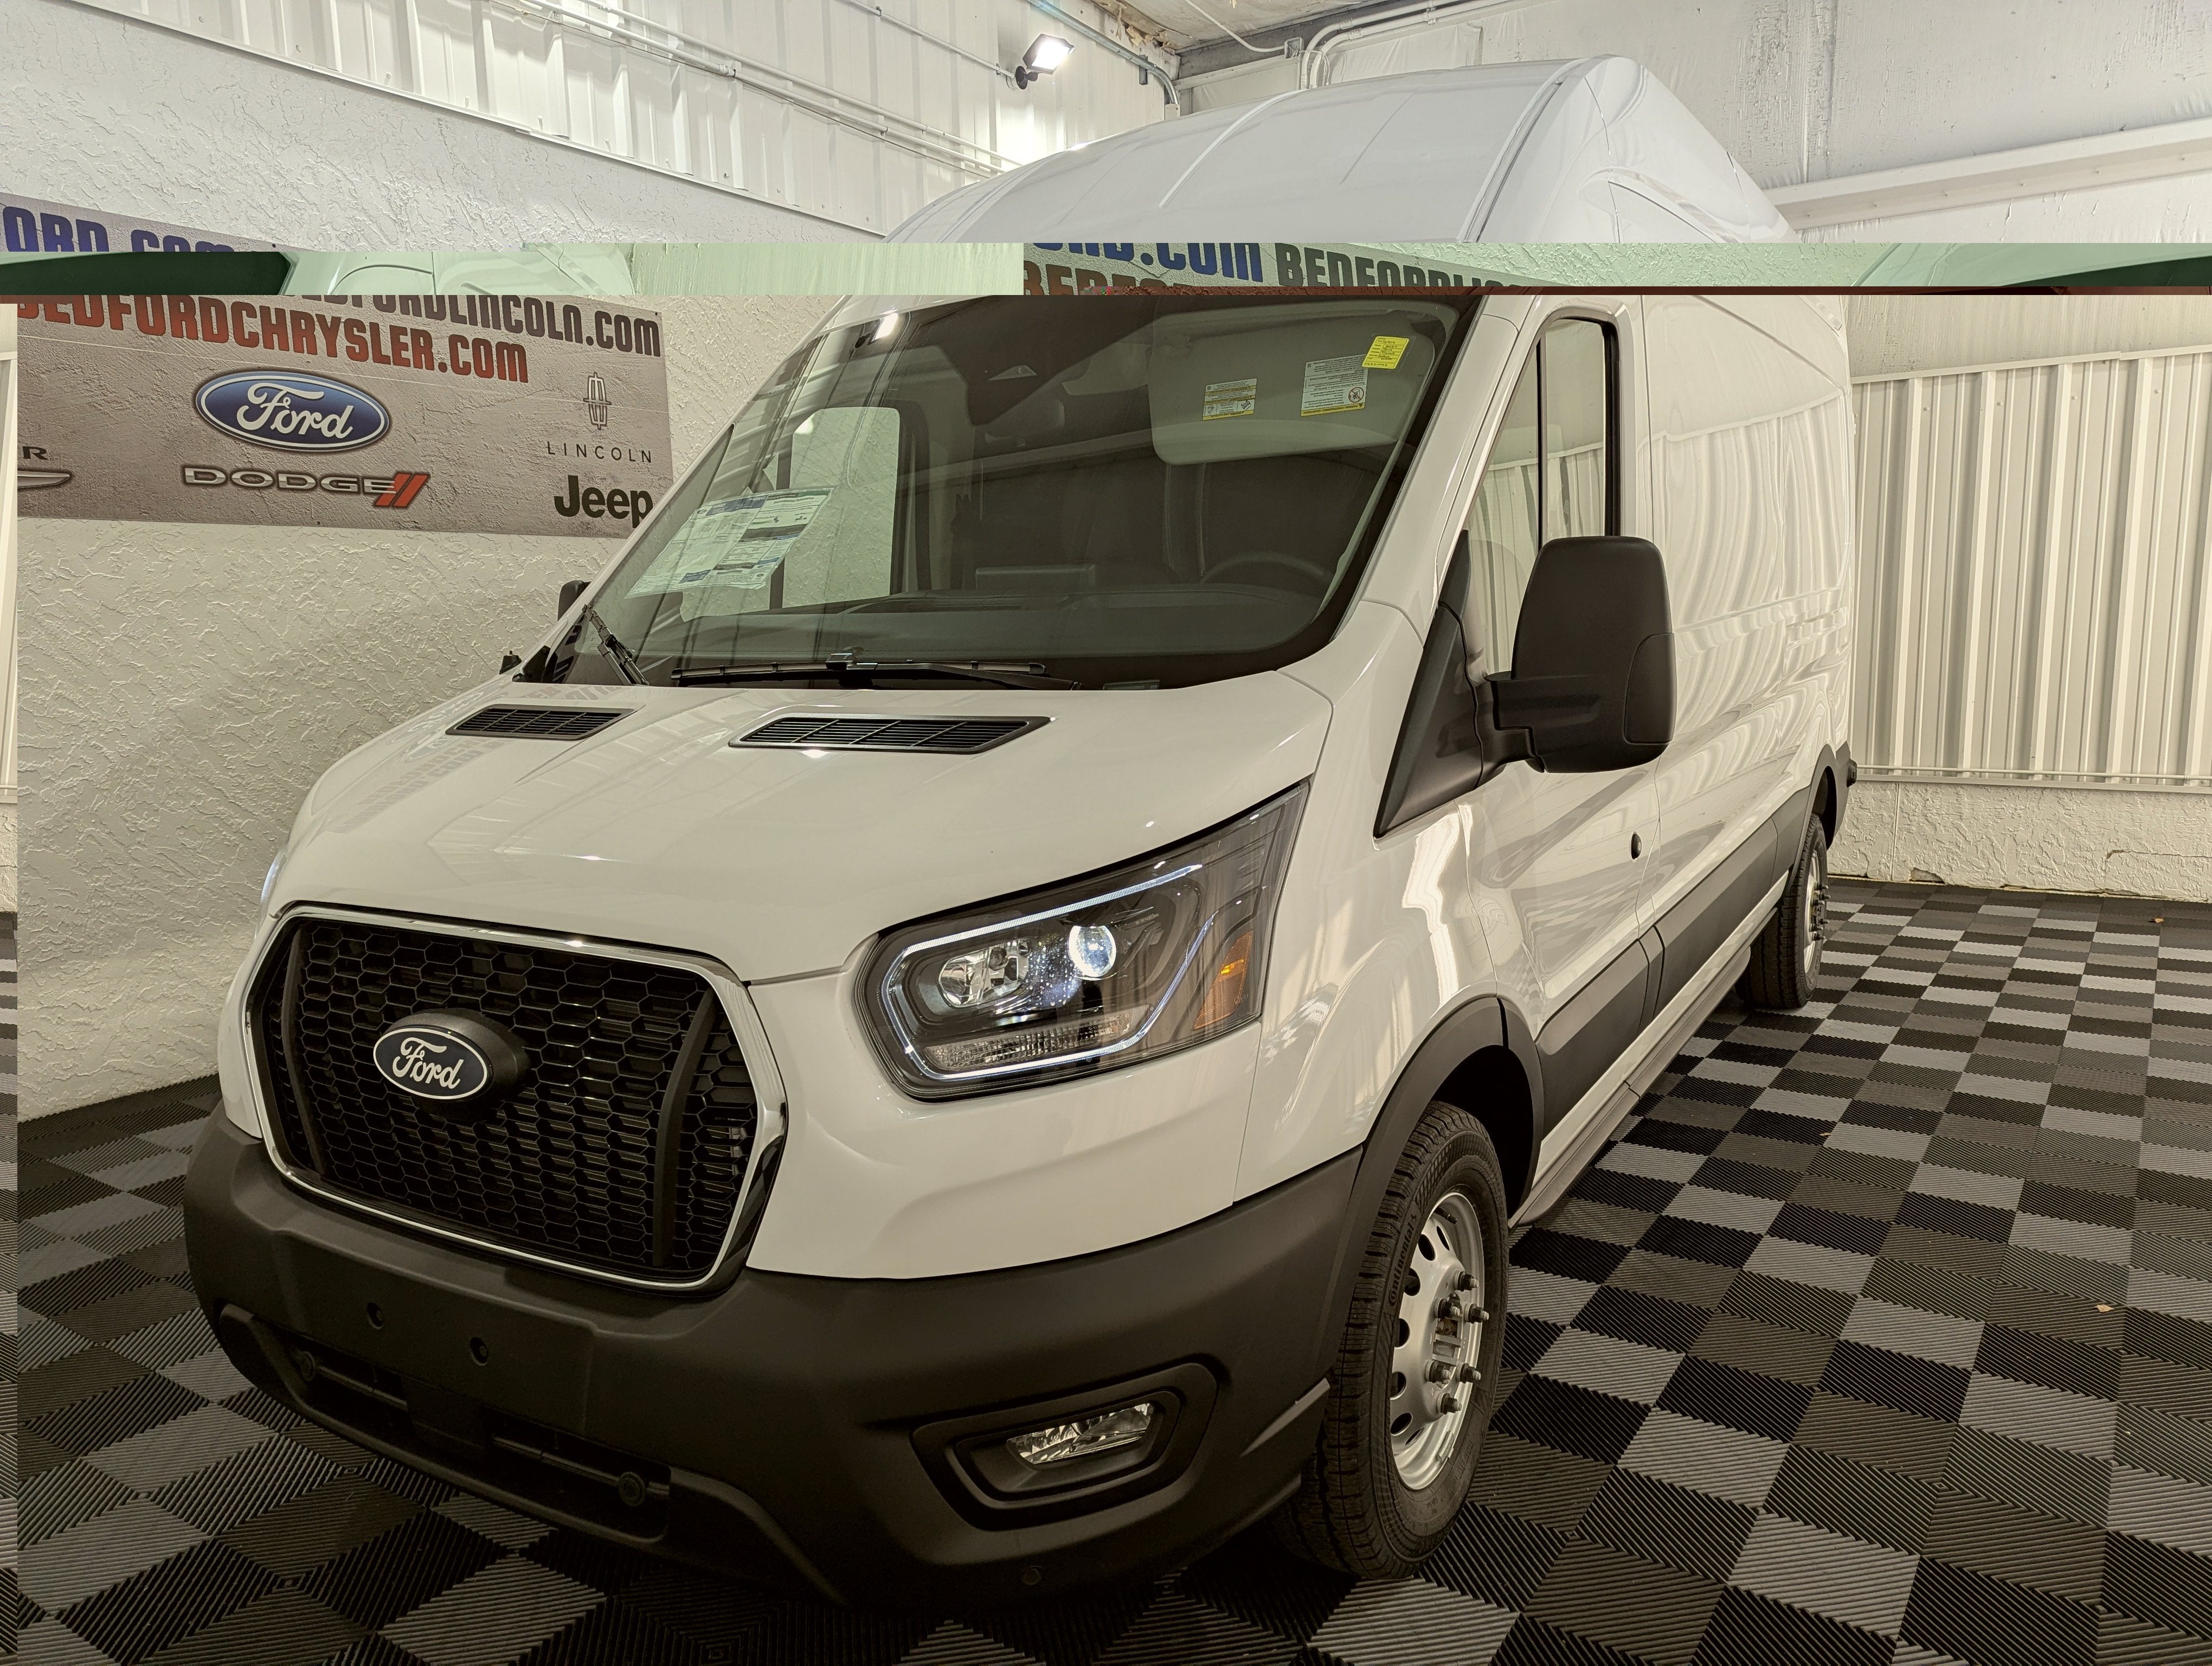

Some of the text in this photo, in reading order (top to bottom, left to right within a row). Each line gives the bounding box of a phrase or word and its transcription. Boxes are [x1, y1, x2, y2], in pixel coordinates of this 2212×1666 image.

[236, 382, 354, 439] Ford
[547, 441, 651, 463] LINCOLN
[184, 467, 397, 494] DODGE
[554, 475, 653, 529] Jeep
[392, 1037, 464, 1089] Ford
[1388, 1222, 1415, 1307] Continental
